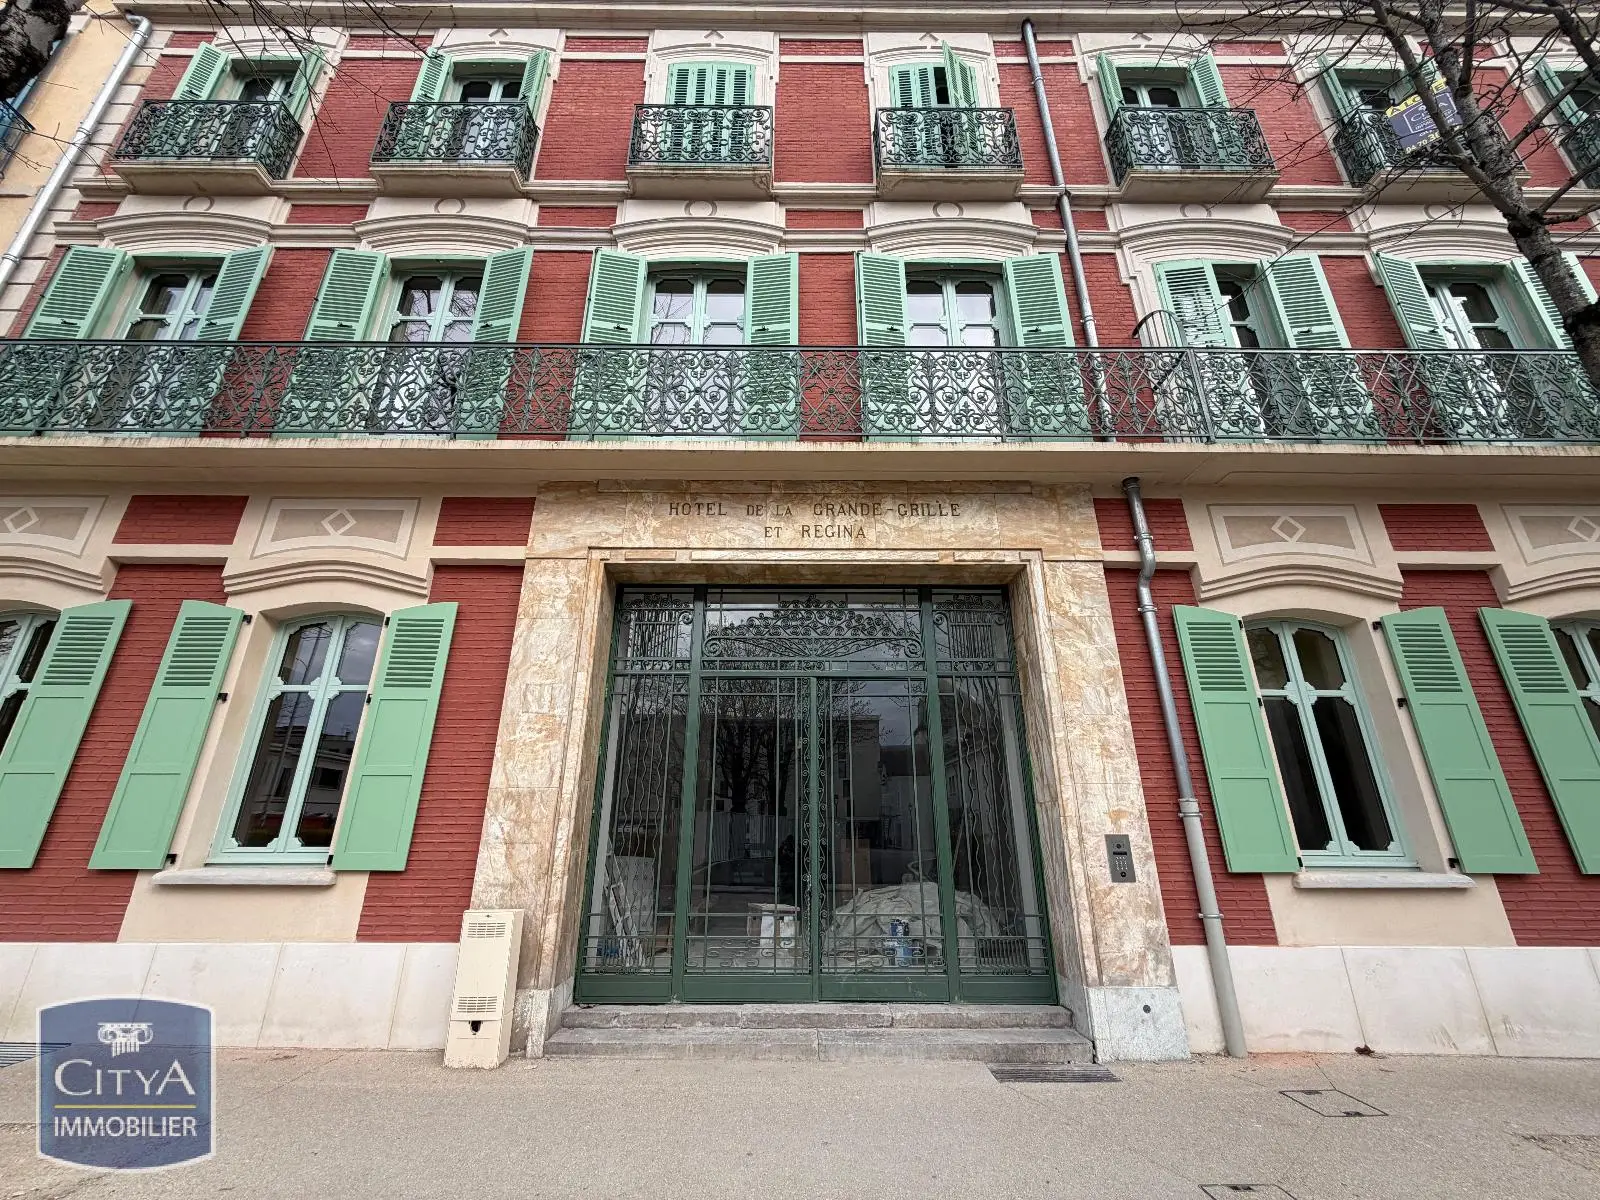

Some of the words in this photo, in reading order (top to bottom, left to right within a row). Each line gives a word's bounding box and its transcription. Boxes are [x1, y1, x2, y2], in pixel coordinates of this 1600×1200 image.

[669, 502, 727, 516] HOTEL
[746, 504, 764, 516] DE
[775, 504, 793, 516] LA
[813, 501, 960, 517] GRANDE-GRILLE
[764, 526, 782, 538] ET
[801, 524, 866, 539] REGINA
